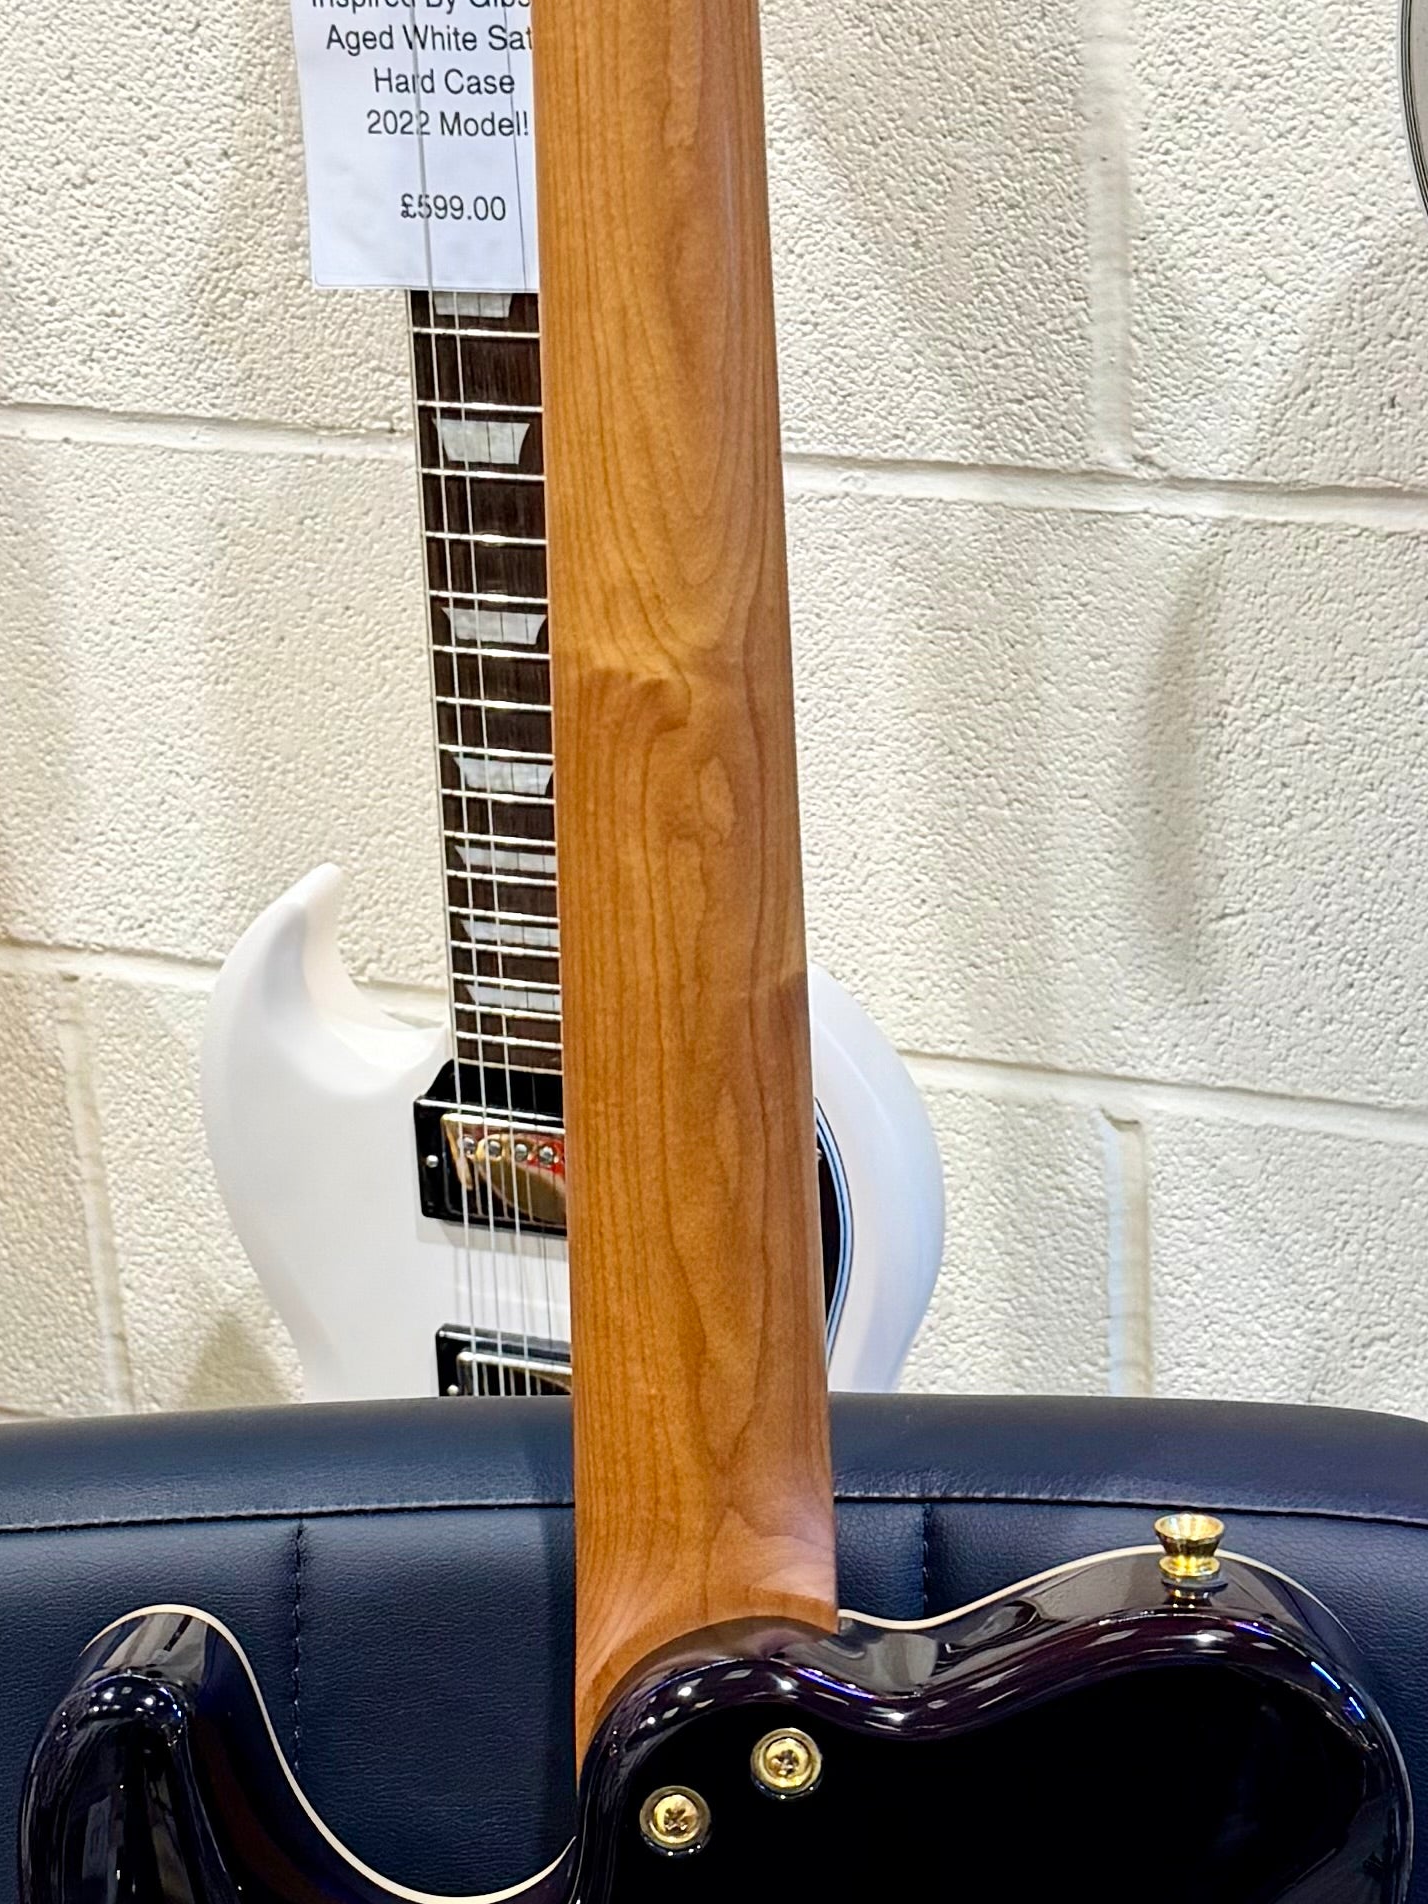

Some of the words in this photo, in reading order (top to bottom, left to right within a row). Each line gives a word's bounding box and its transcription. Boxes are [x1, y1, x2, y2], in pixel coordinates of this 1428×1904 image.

[326, 26, 393, 57] Aged
[406, 25, 477, 52] White
[374, 68, 436, 94] Hard
[445, 69, 515, 95] Case
[366, 111, 430, 136] 2022
[440, 111, 528, 137] Model!
[401, 195, 506, 221] £599.00
